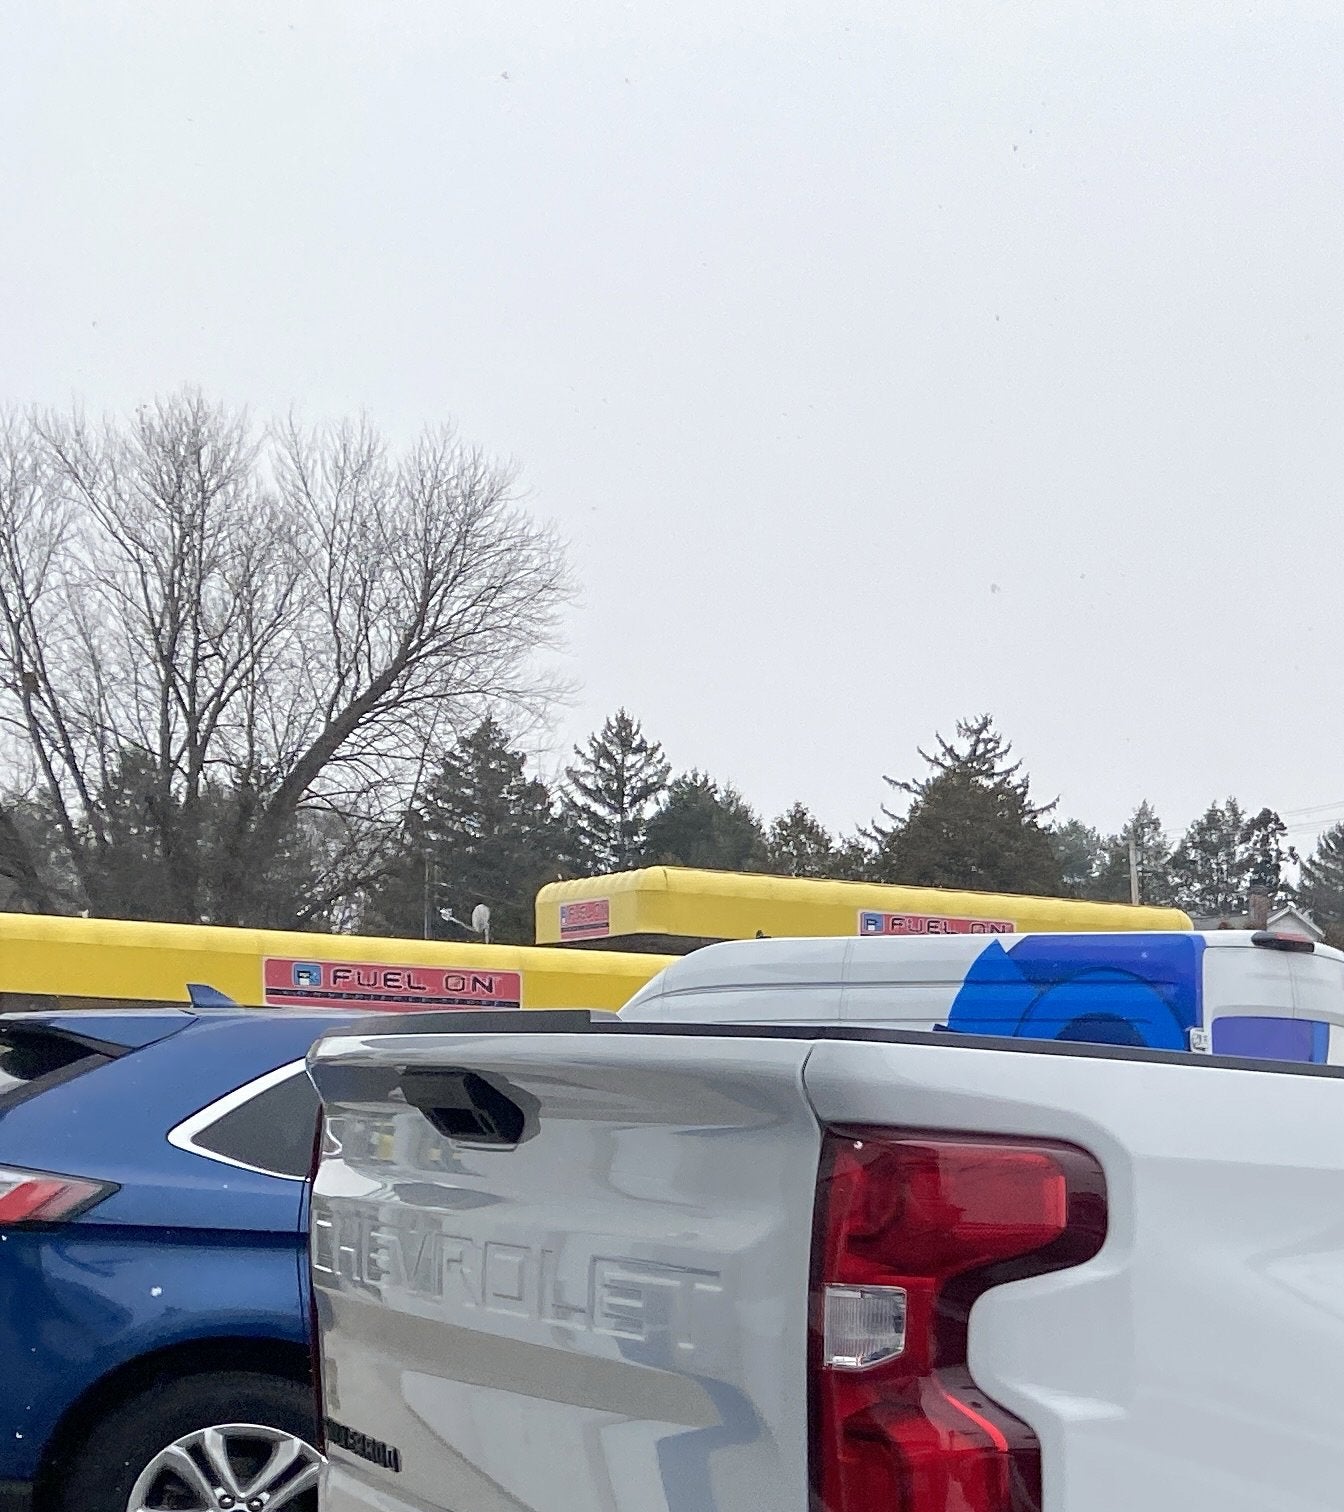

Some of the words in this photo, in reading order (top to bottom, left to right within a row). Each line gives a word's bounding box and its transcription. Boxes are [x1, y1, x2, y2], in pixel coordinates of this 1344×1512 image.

[890, 917, 960, 934] FUEL
[332, 968, 427, 991] FUEL
[445, 974, 495, 994] ON
[313, 1203, 722, 1350] CHEVROLET
